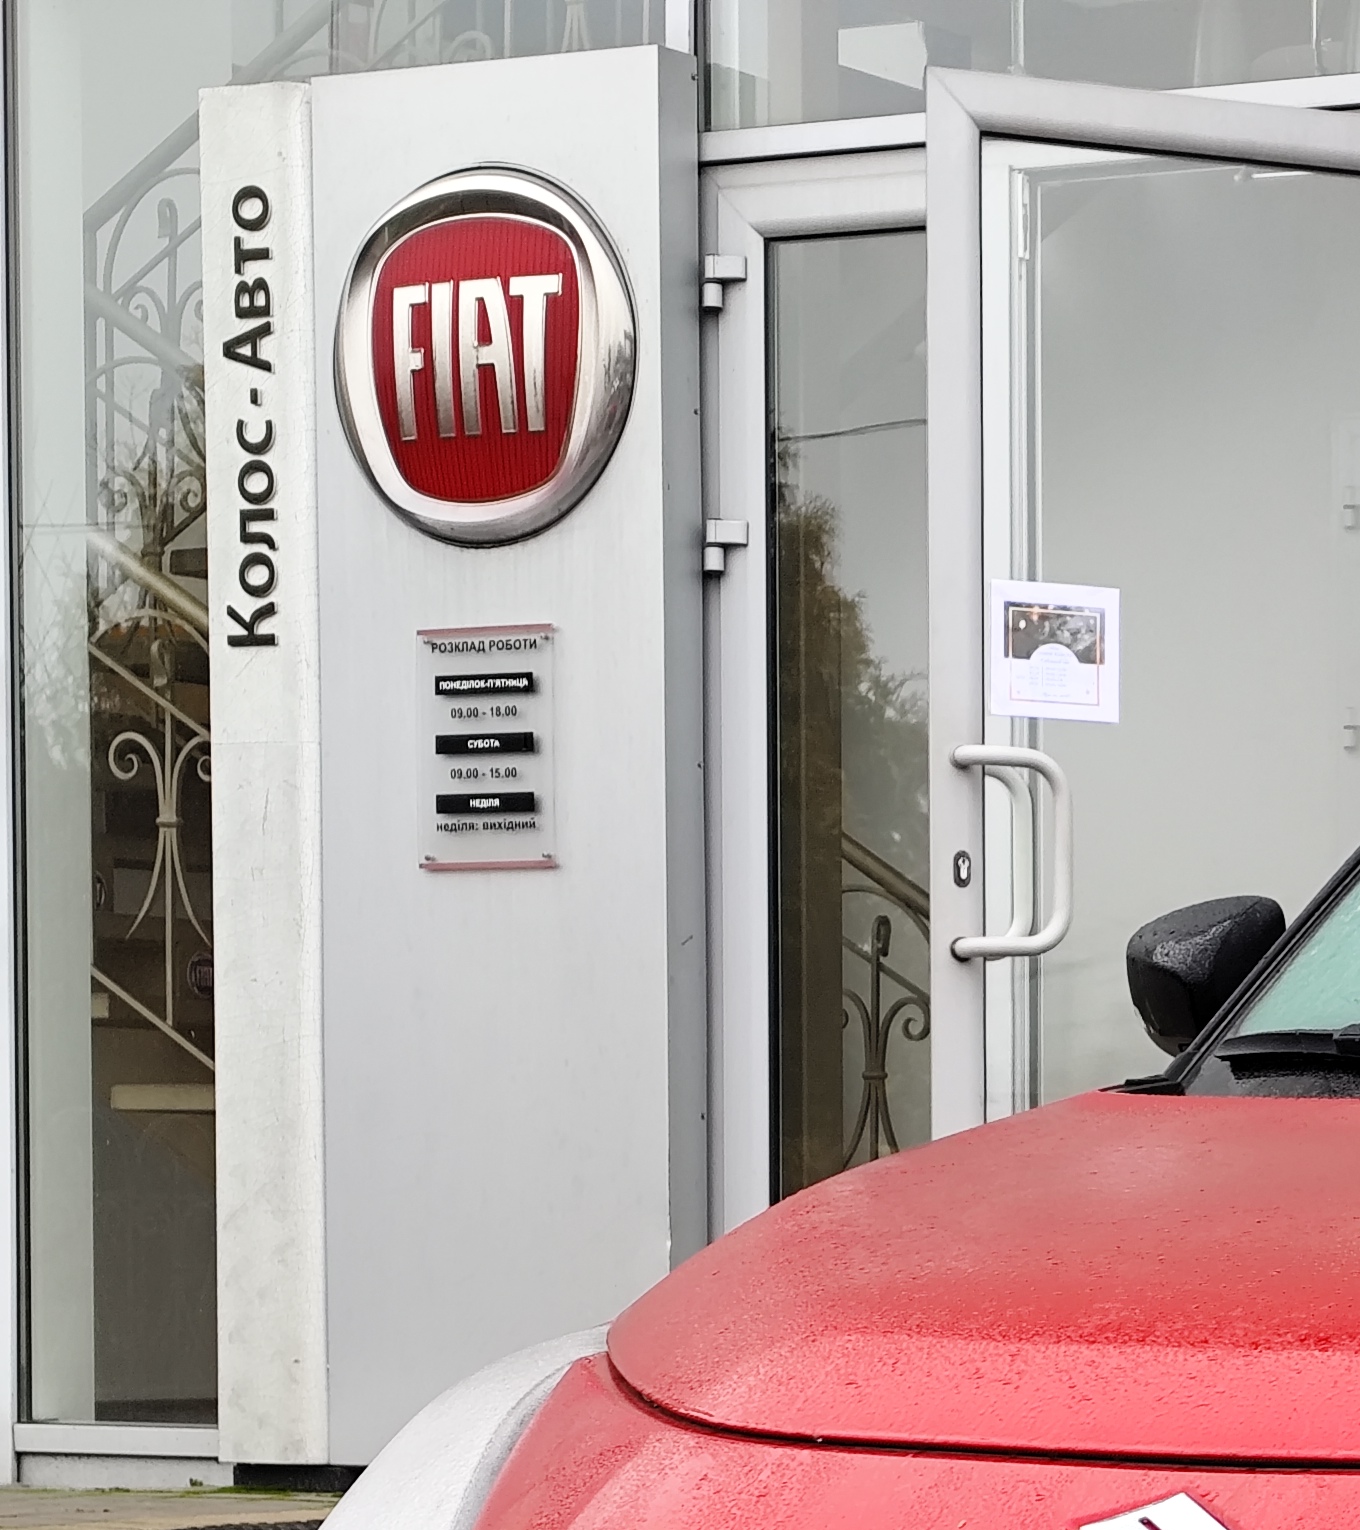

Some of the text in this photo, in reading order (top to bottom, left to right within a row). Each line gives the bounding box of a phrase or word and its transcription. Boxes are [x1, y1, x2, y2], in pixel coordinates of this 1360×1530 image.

[391, 273, 562, 441] FIAT
[431, 639, 537, 653] РОЗКЛАД РОБОТИ
[450, 707, 479, 719] 09.00
[490, 705, 517, 718] 18.00
[467, 738, 500, 749] СУБОТА
[450, 767, 479, 779] 09.00
[489, 767, 517, 779] 15.00
[470, 797, 500, 809] НЕДІЛЯ
[482, 817, 536, 831] вихідний
